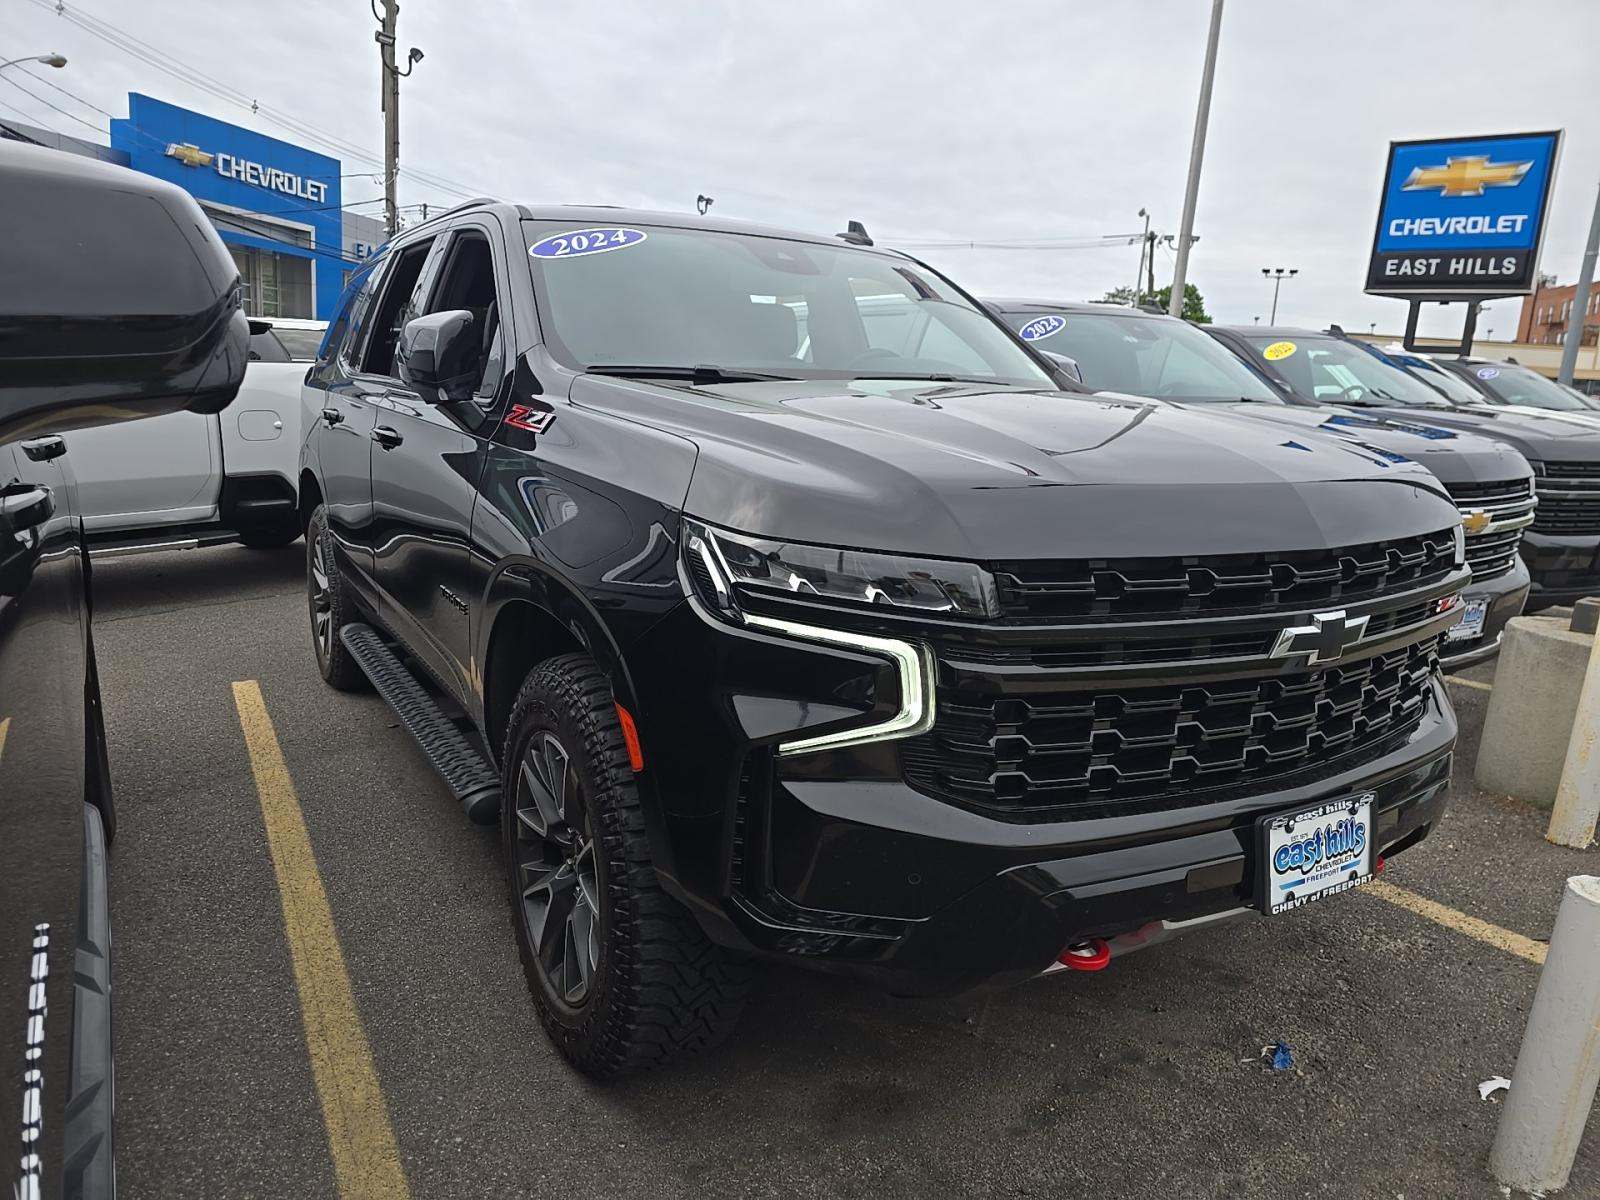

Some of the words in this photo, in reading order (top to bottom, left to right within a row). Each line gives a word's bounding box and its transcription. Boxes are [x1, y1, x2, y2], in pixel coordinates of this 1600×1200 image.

[216, 152, 328, 204] CHEVROLET
[1389, 214, 1528, 236] CHEVROLET
[552, 228, 627, 256] 2024
[1385, 258, 1441, 276] EAST
[1449, 257, 1517, 275] HILLS
[1026, 317, 1060, 339] 2024
[504, 403, 556, 434] Z71
[1295, 806, 1325, 822] east
[1325, 800, 1353, 814] hills
[1273, 827, 1324, 876] east
[1324, 816, 1366, 860] hills
[1315, 854, 1353, 872] CHEVROLET
[1306, 868, 1340, 883] FREEPORT
[1272, 896, 1309, 915] CHEVY
[1311, 892, 1320, 902] of
[1322, 874, 1373, 898] FREEPORT
